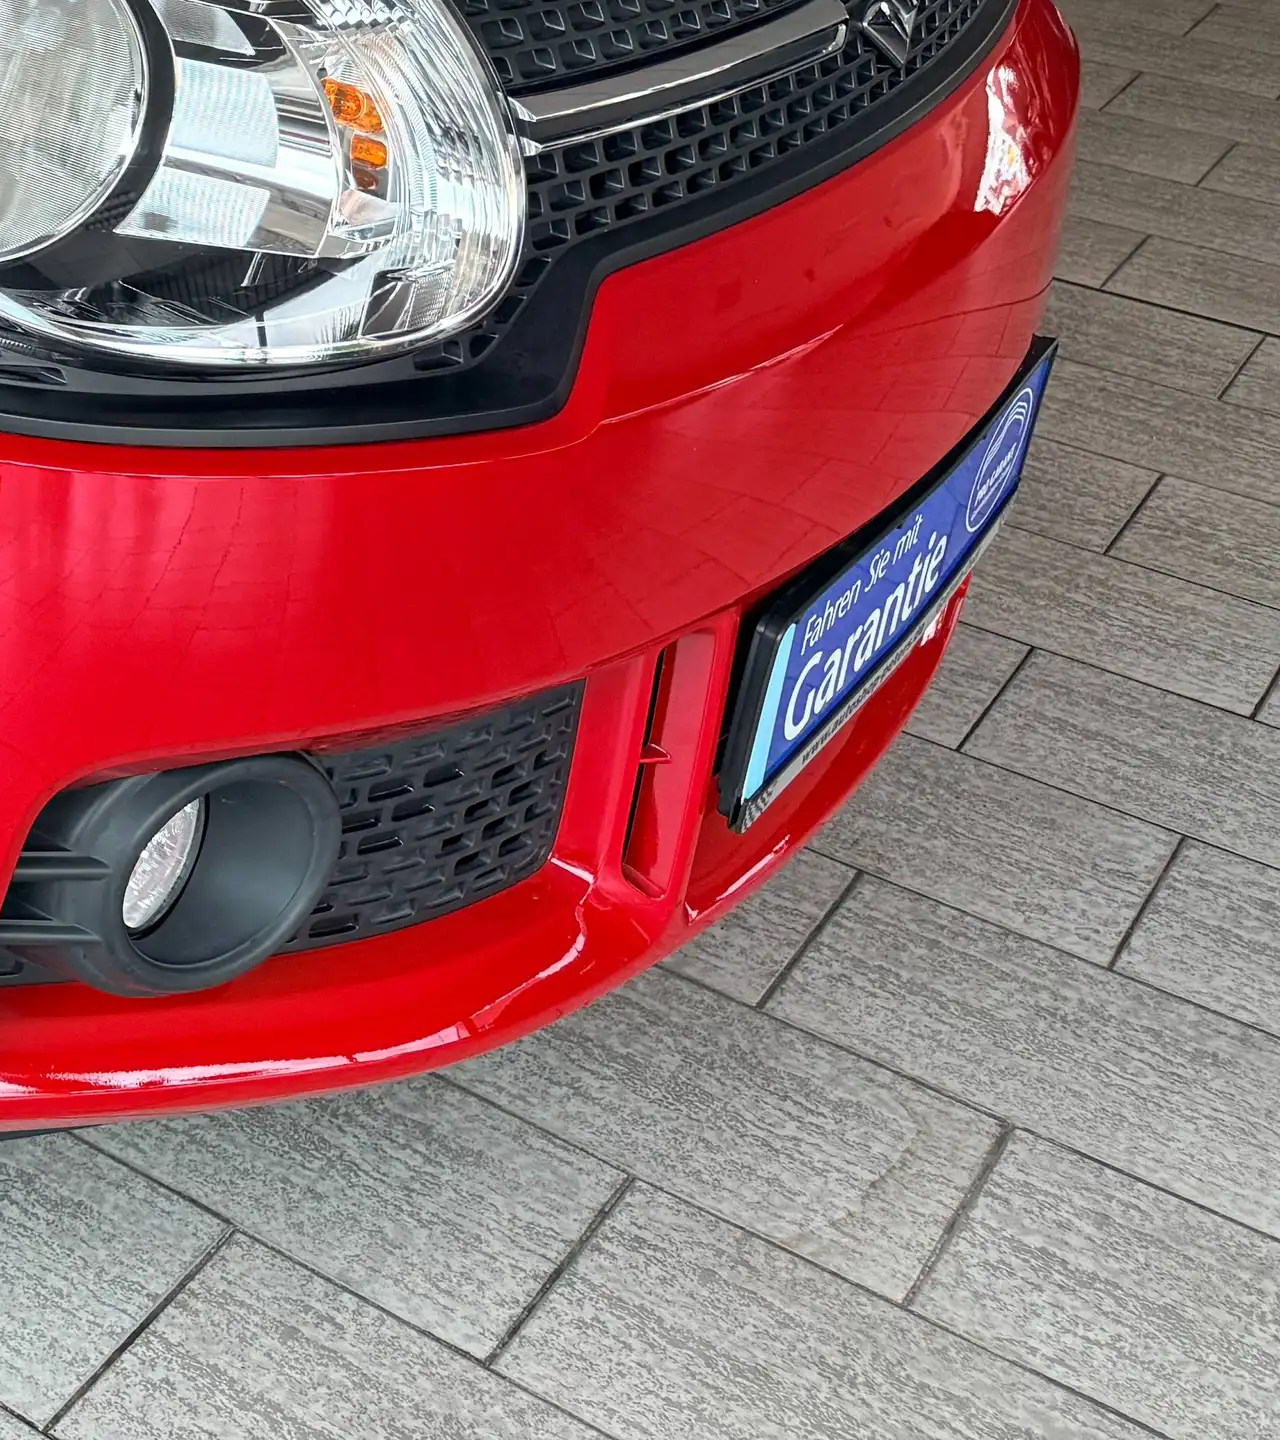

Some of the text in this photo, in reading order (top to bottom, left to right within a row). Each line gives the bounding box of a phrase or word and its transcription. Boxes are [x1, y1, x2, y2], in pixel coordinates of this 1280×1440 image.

[784, 531, 948, 741] Garantie
[801, 514, 923, 656] Fahren Sie mit
